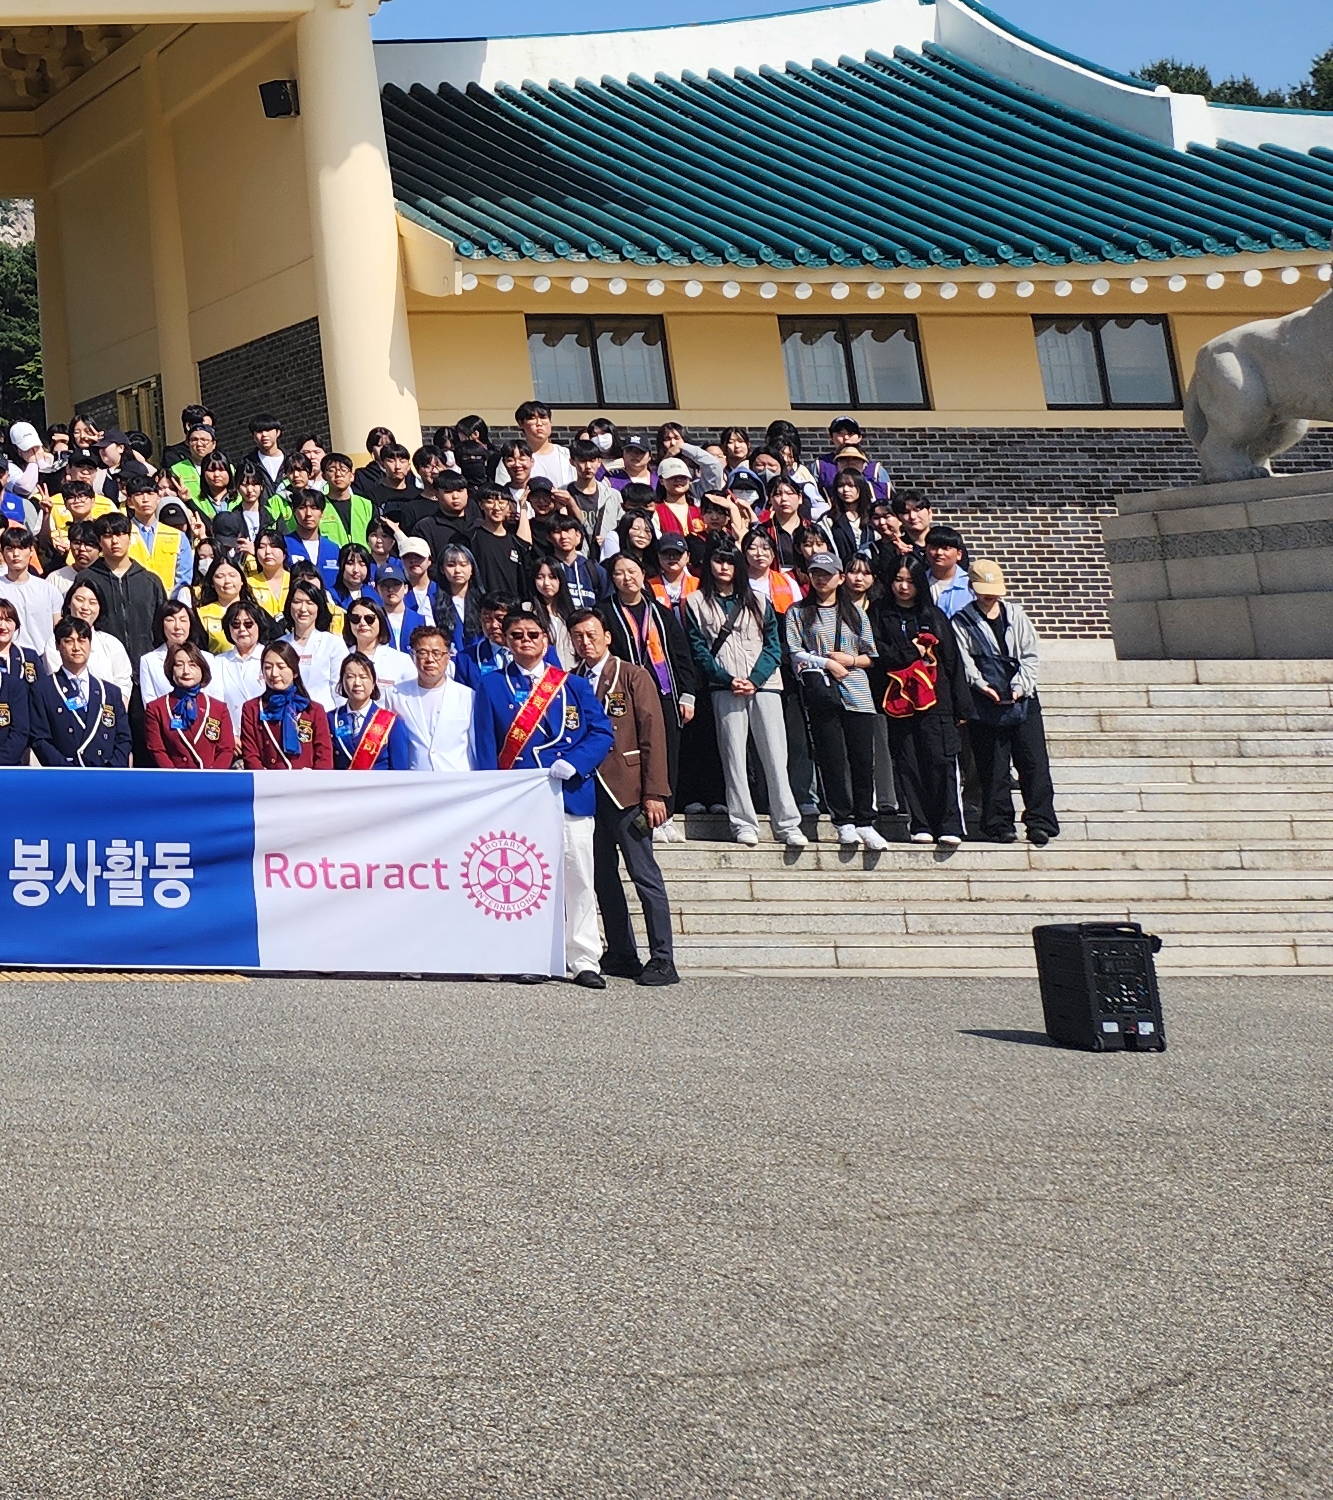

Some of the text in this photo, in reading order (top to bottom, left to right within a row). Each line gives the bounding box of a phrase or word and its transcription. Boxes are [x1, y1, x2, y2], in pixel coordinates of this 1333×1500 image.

[484, 840, 523, 851] ROTARY
[8, 838, 194, 909] 봉사활동
[264, 852, 450, 890] Rotaract
[476, 889, 539, 912] INTERNATIONAL
